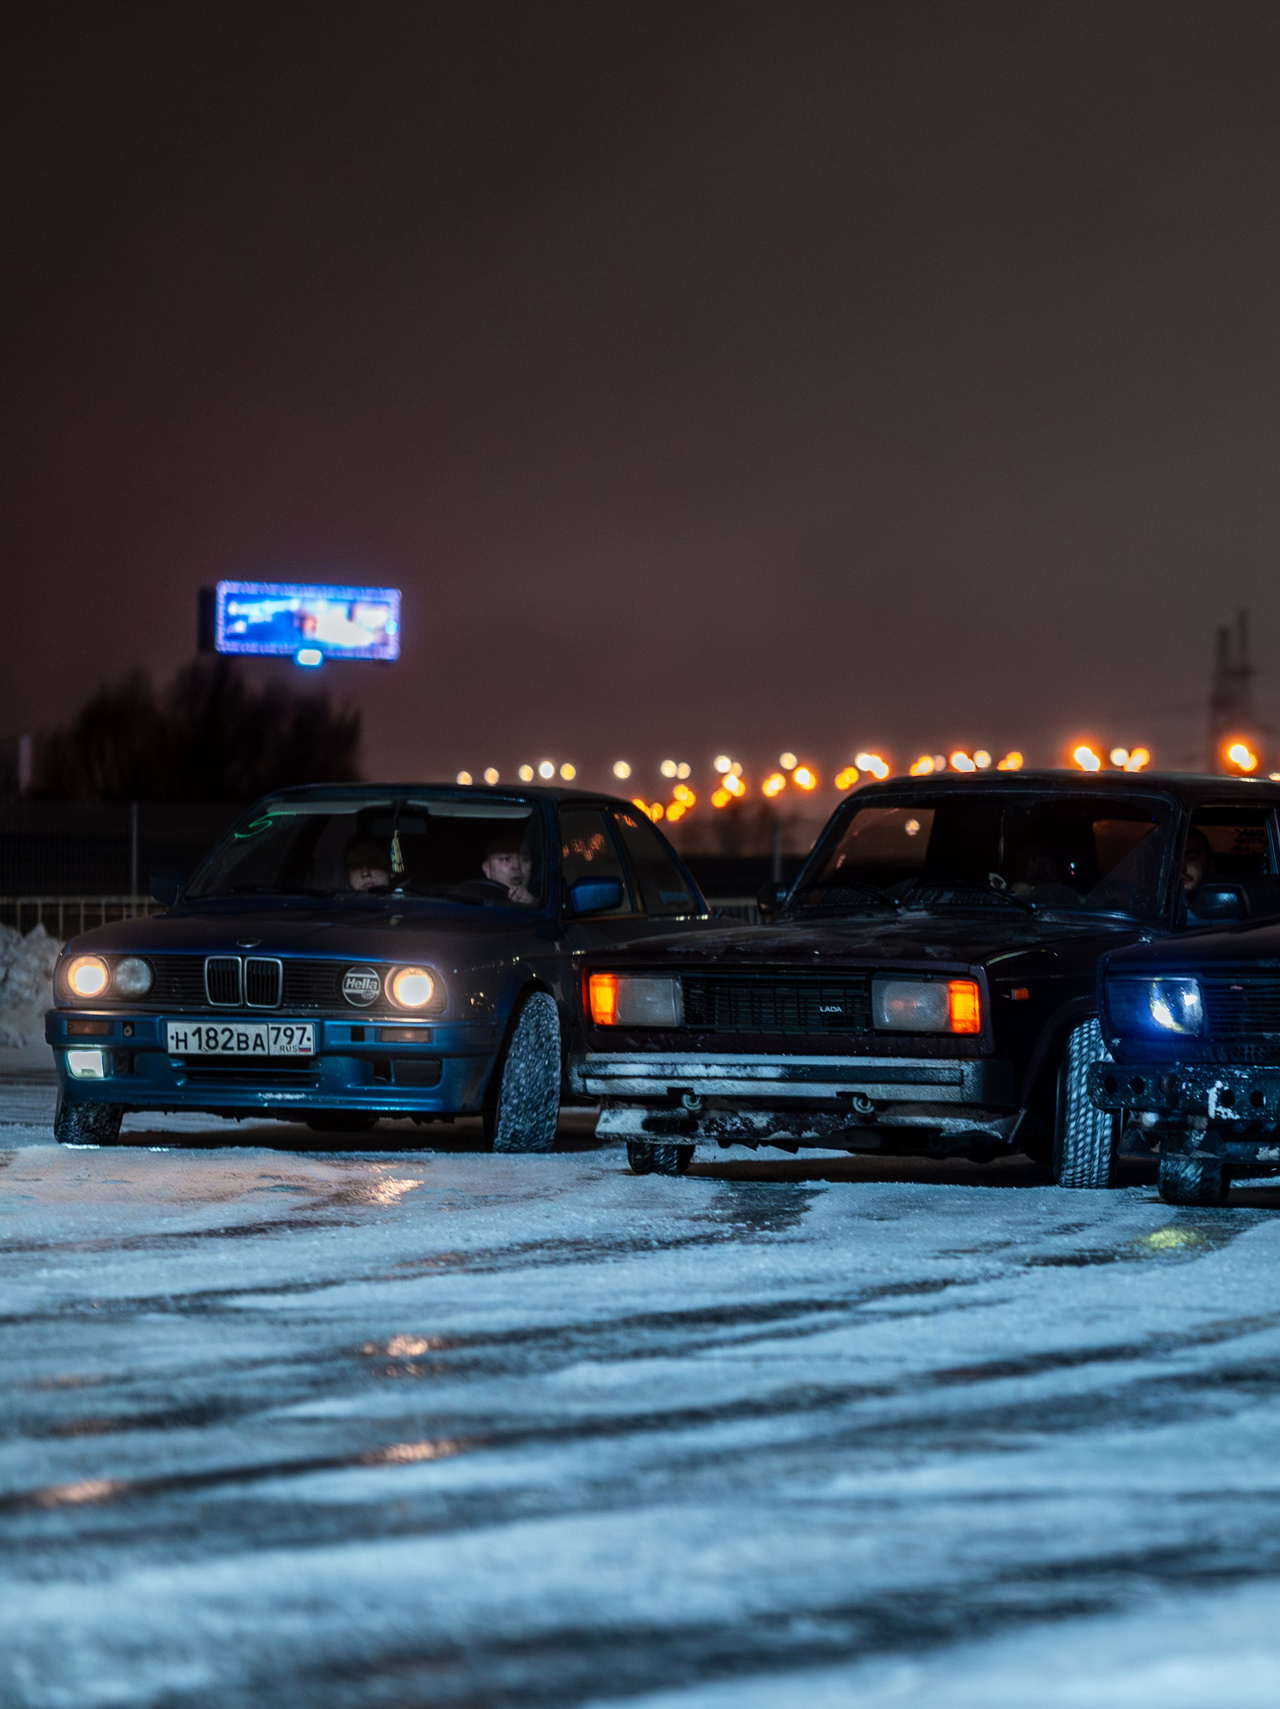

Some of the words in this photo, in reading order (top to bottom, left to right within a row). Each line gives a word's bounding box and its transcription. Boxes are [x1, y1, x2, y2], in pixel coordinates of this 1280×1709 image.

[345, 977, 378, 990] Hella
[819, 1005, 843, 1013] LADA
[270, 1026, 307, 1046] 797
[279, 1045, 299, 1053] RUS
